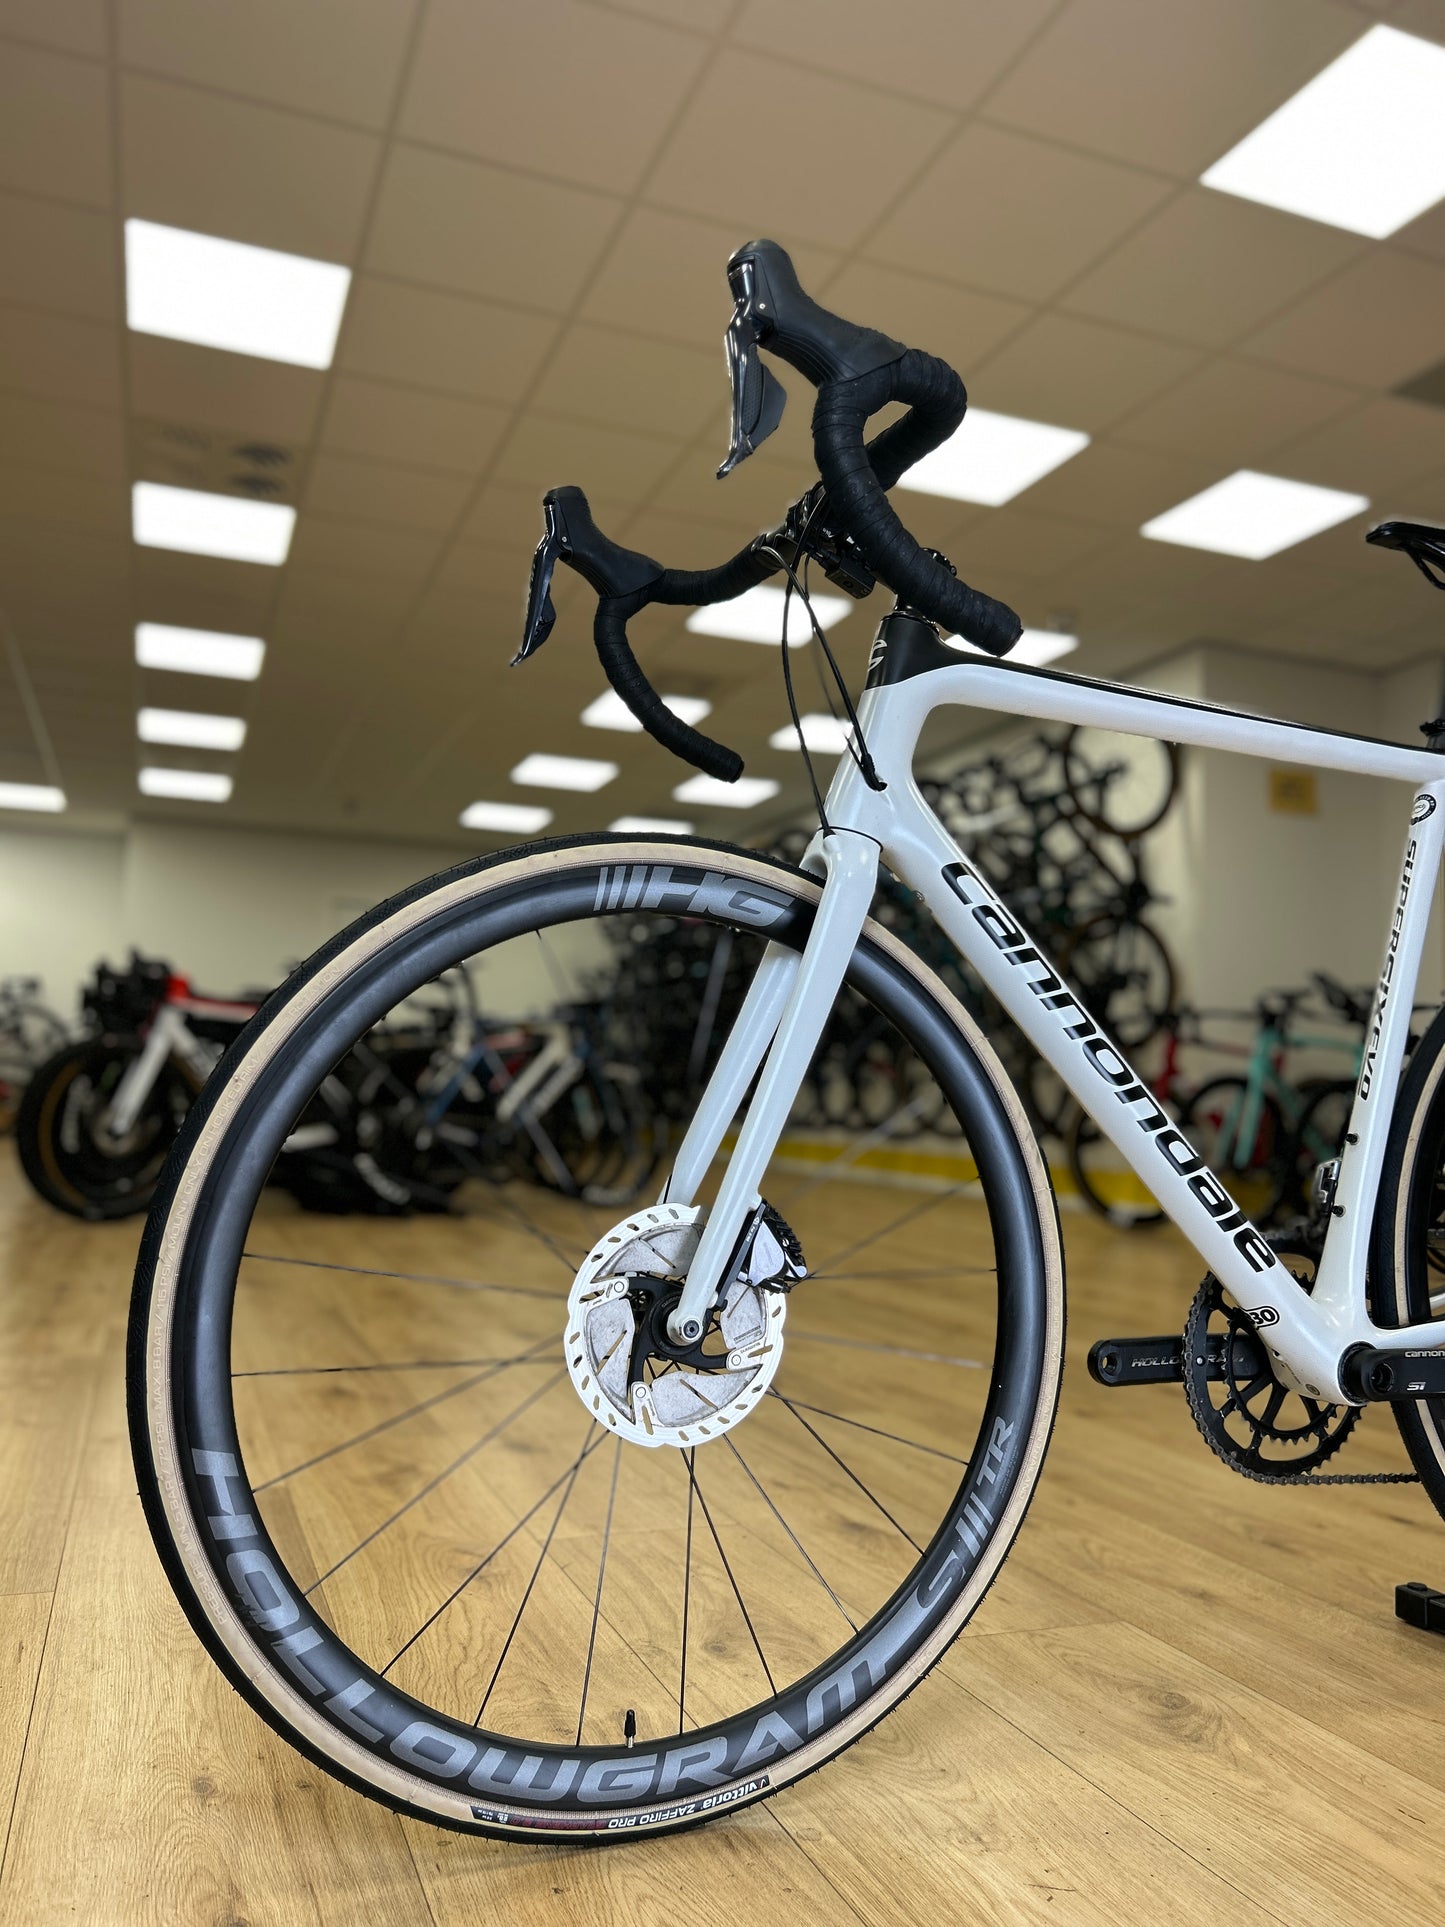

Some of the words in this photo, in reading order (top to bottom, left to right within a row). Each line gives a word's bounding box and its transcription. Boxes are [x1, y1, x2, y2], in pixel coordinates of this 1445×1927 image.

[941, 862, 1276, 1272] cannondale
[208, 1080, 243, 1135] HOOKED
[197, 1134, 214, 1157] ON
[182, 1159, 203, 1195] ONLY
[159, 1262, 171, 1286] PSI
[152, 1325, 162, 1356] BAR
[154, 1421, 166, 1443] PSI
[163, 1479, 180, 1510] BAR
[188, 1557, 228, 1625] PRESSURE
[193, 1447, 905, 1802] HOLLOWGRAM
[607, 1816, 637, 1828] PRO
[638, 1802, 697, 1824] ZAFFIRO
